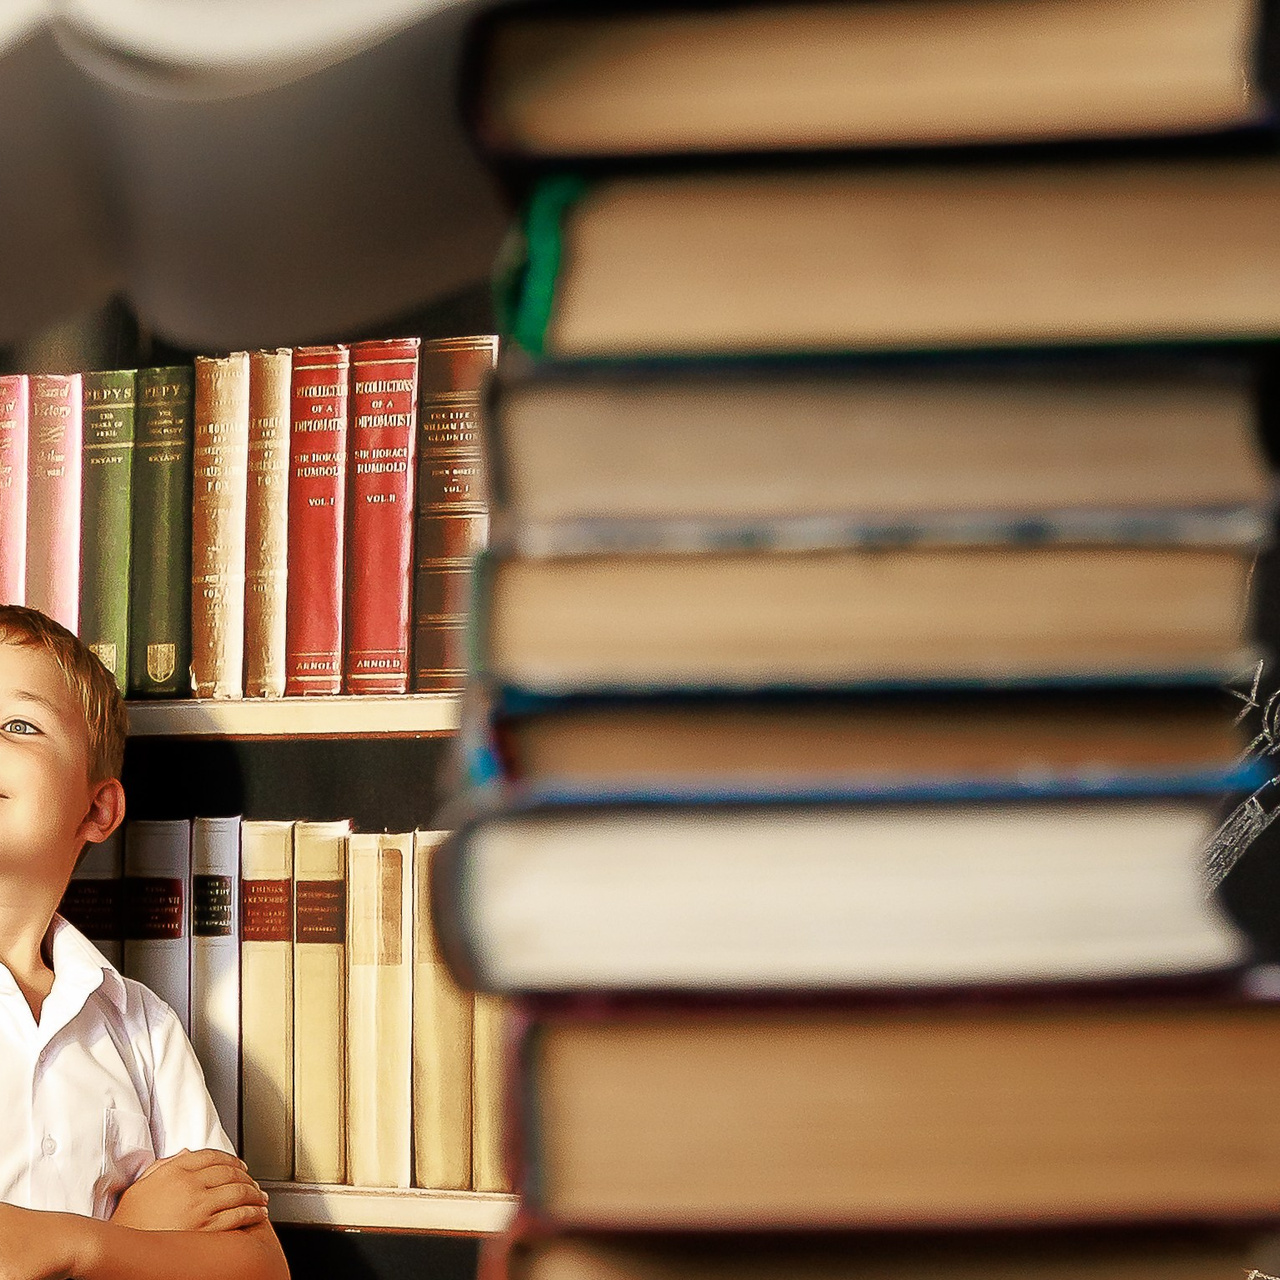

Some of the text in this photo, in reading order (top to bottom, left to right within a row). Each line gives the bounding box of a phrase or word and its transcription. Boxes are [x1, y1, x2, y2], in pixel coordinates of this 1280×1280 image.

[326, 404, 333, 413] A
[371, 400, 394, 409] OF A
